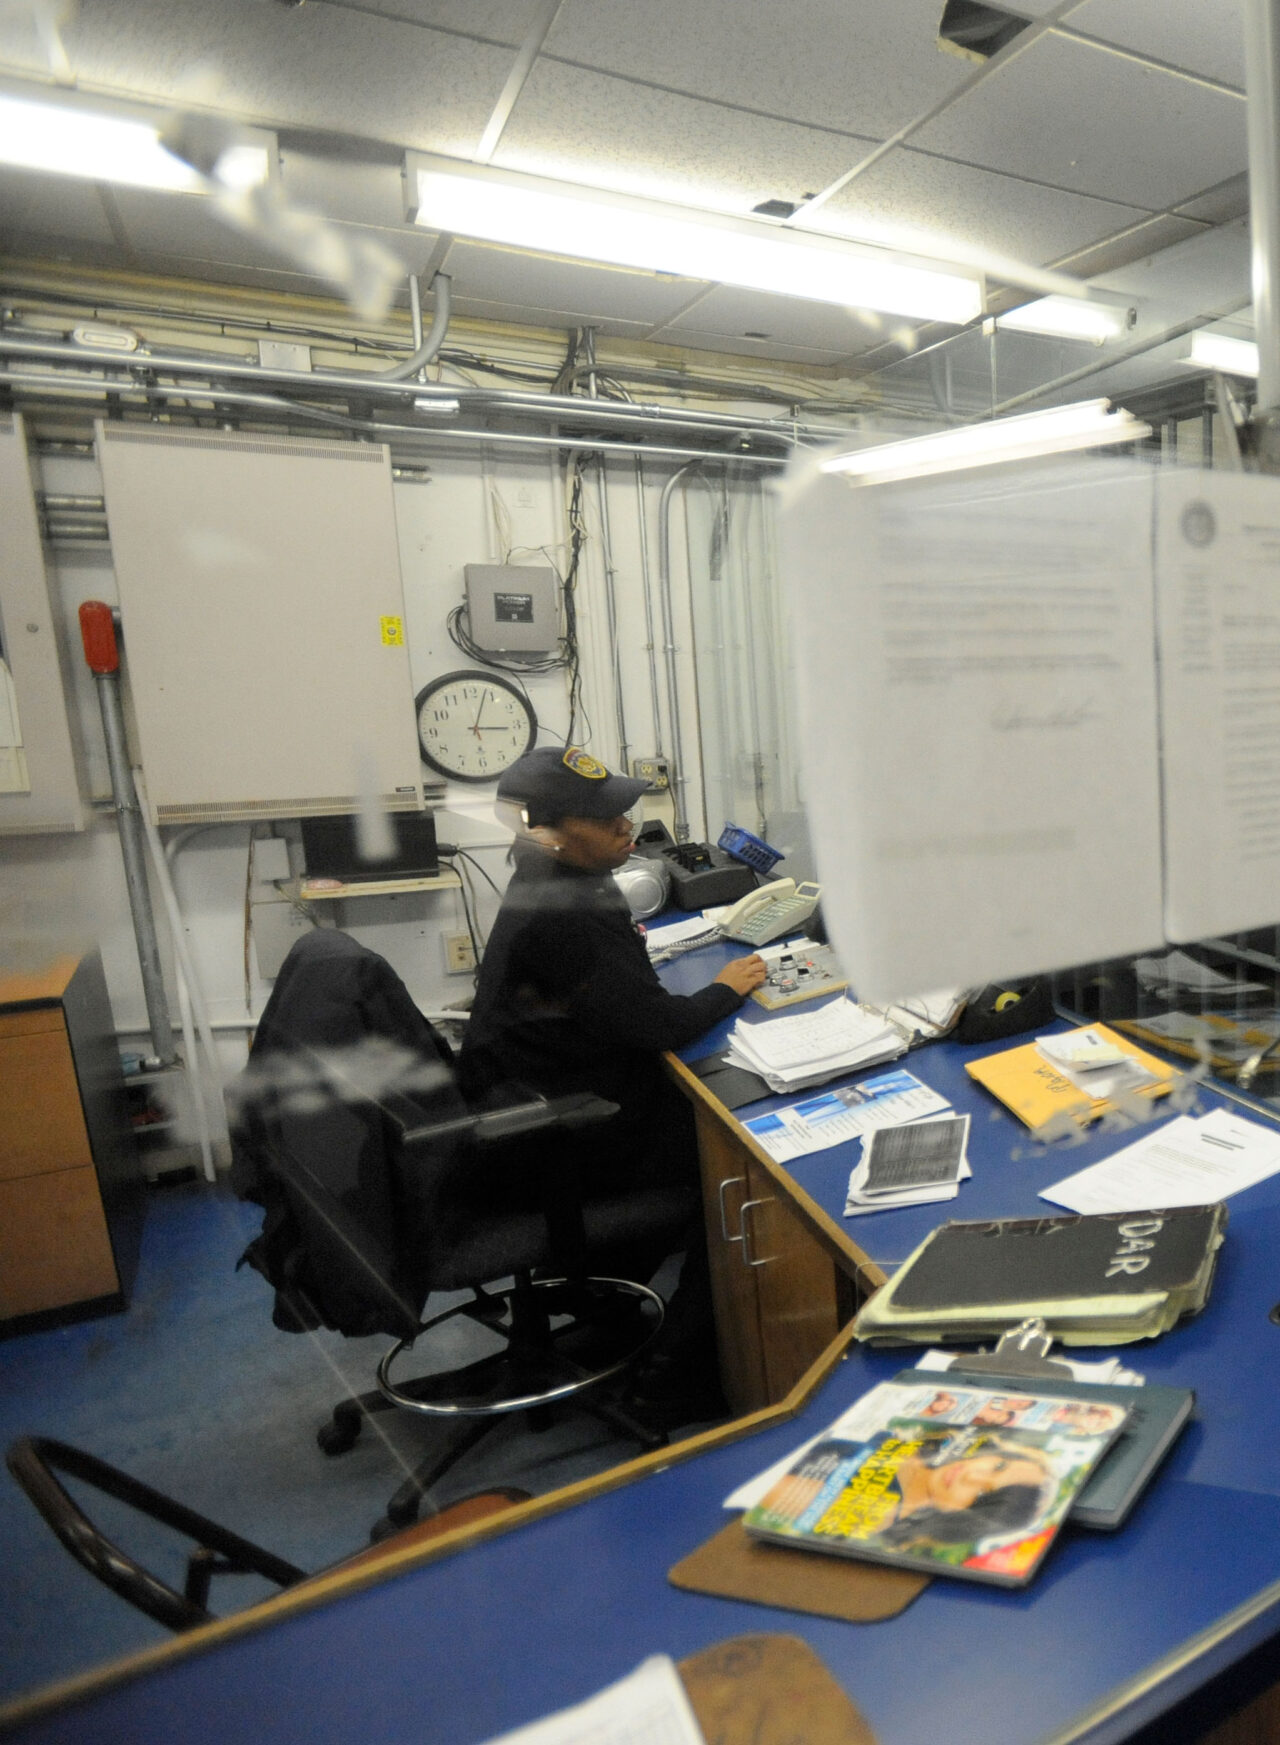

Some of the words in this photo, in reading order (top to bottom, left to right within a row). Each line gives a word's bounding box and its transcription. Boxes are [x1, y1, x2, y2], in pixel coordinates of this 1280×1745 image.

[463, 687, 478, 700] 12
[444, 695, 457, 706] 11
[505, 703, 513, 714] 2
[434, 709, 449, 722] 10
[512, 719, 521, 730] 3
[429, 727, 438, 738] 9
[479, 757, 488, 773] 6
[1105, 1218, 1163, 1277] DAR
[812, 1450, 895, 1534] HAPPINESS
[838, 1440, 925, 1538] HEARTBREAK
[849, 1490, 902, 1540] FROM
